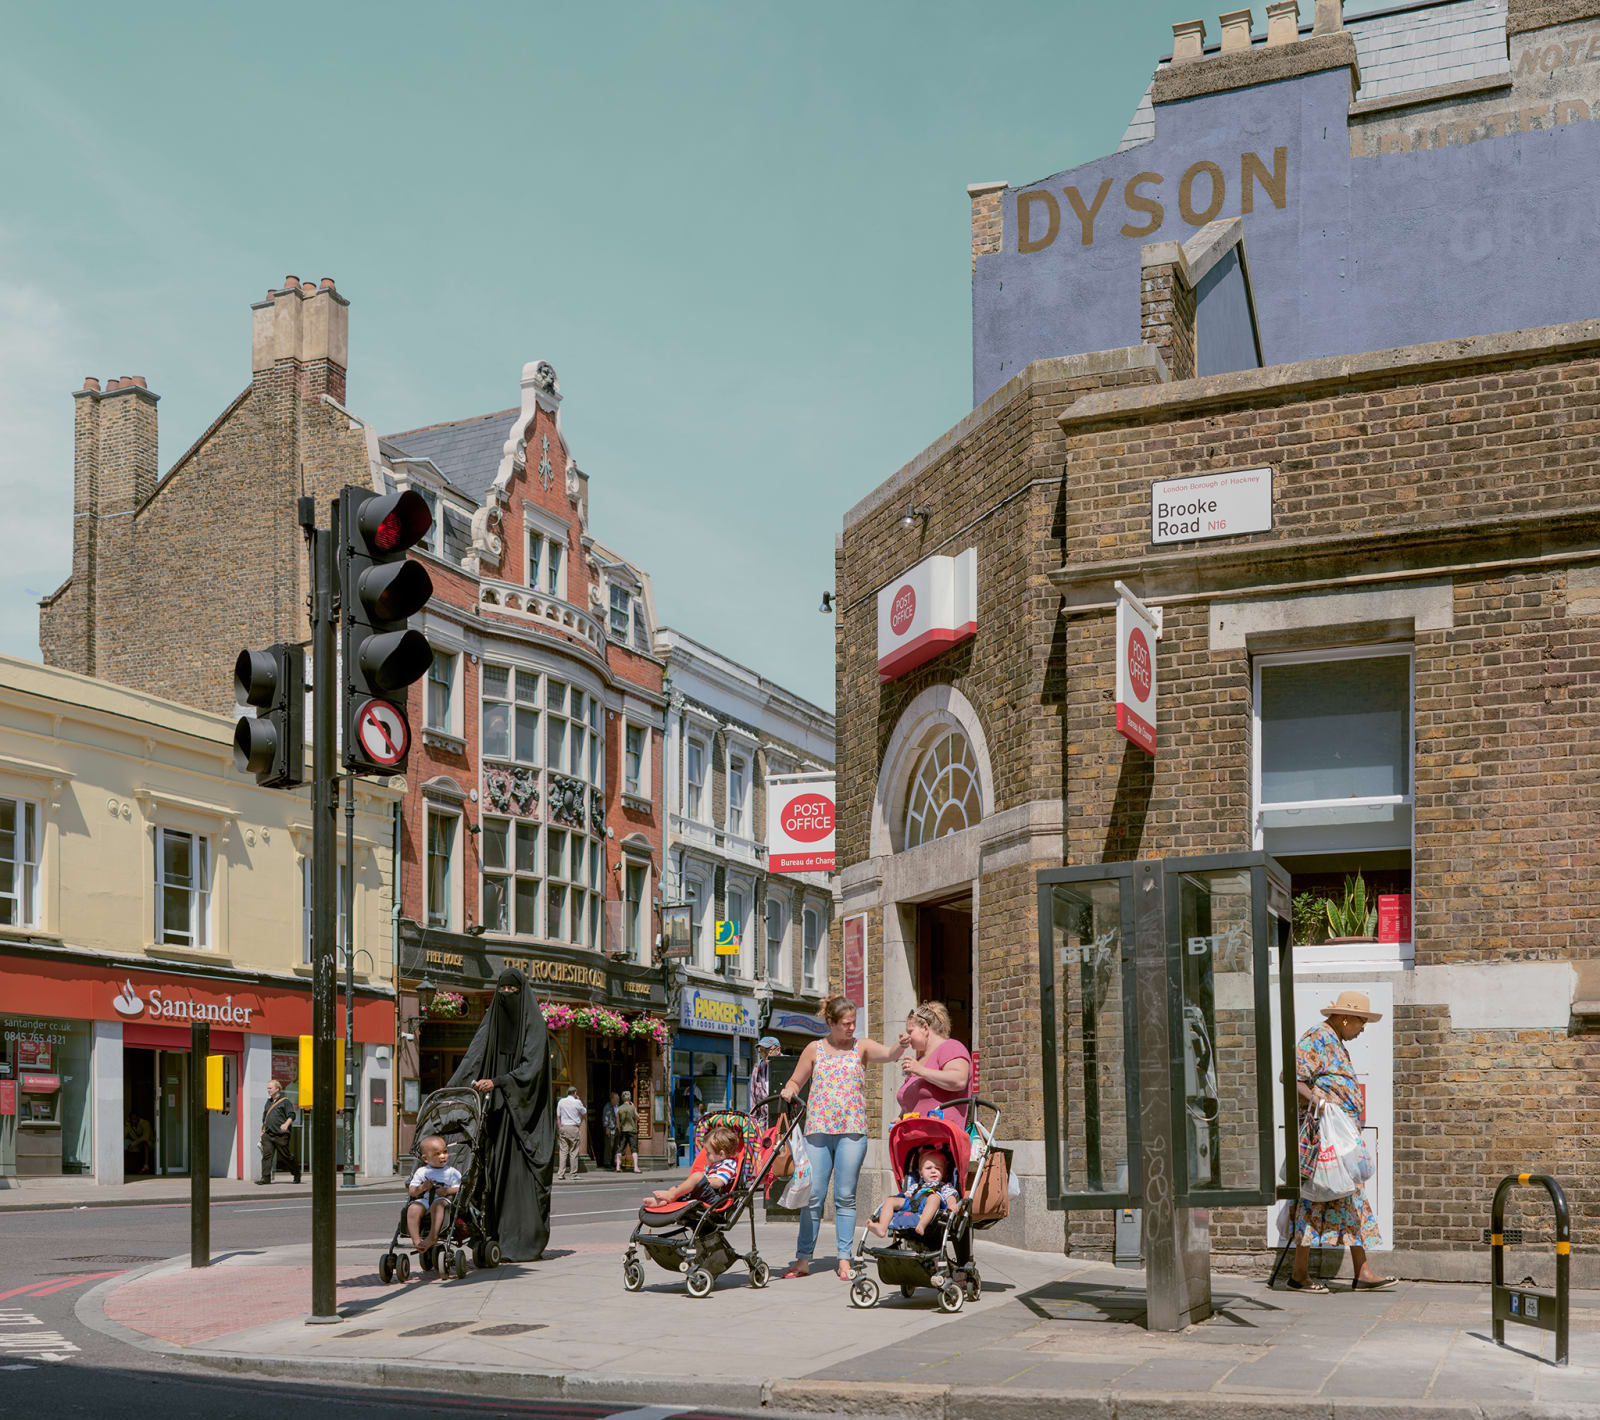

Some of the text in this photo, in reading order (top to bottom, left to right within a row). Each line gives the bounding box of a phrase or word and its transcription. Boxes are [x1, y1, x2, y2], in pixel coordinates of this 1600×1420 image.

[1016, 147, 1288, 254] DYSON
[1190, 481, 1218, 490] Borough
[1230, 476, 1260, 484] Hackney
[1158, 499, 1217, 518] Brooke
[1158, 517, 1227, 537] Road N16
[896, 592, 911, 612] POST
[893, 604, 913, 627] OFFICE
[1133, 639, 1147, 666] POST
[1130, 658, 1149, 689] OFFICE
[794, 802, 827, 816] POST
[786, 816, 831, 831] OFFICE
[1061, 944, 1095, 964] BT
[1188, 935, 1225, 955] BT
[504, 957, 607, 989] THE ROCHESTER CAS
[149, 989, 253, 1023] Santander
[4, 1019, 71, 1031] santanderco.uk
[684, 1018, 694, 1026] PET
[697, 1020, 715, 1029] FOODS
[4, 1031, 66, 1045] 0845 765 4321
